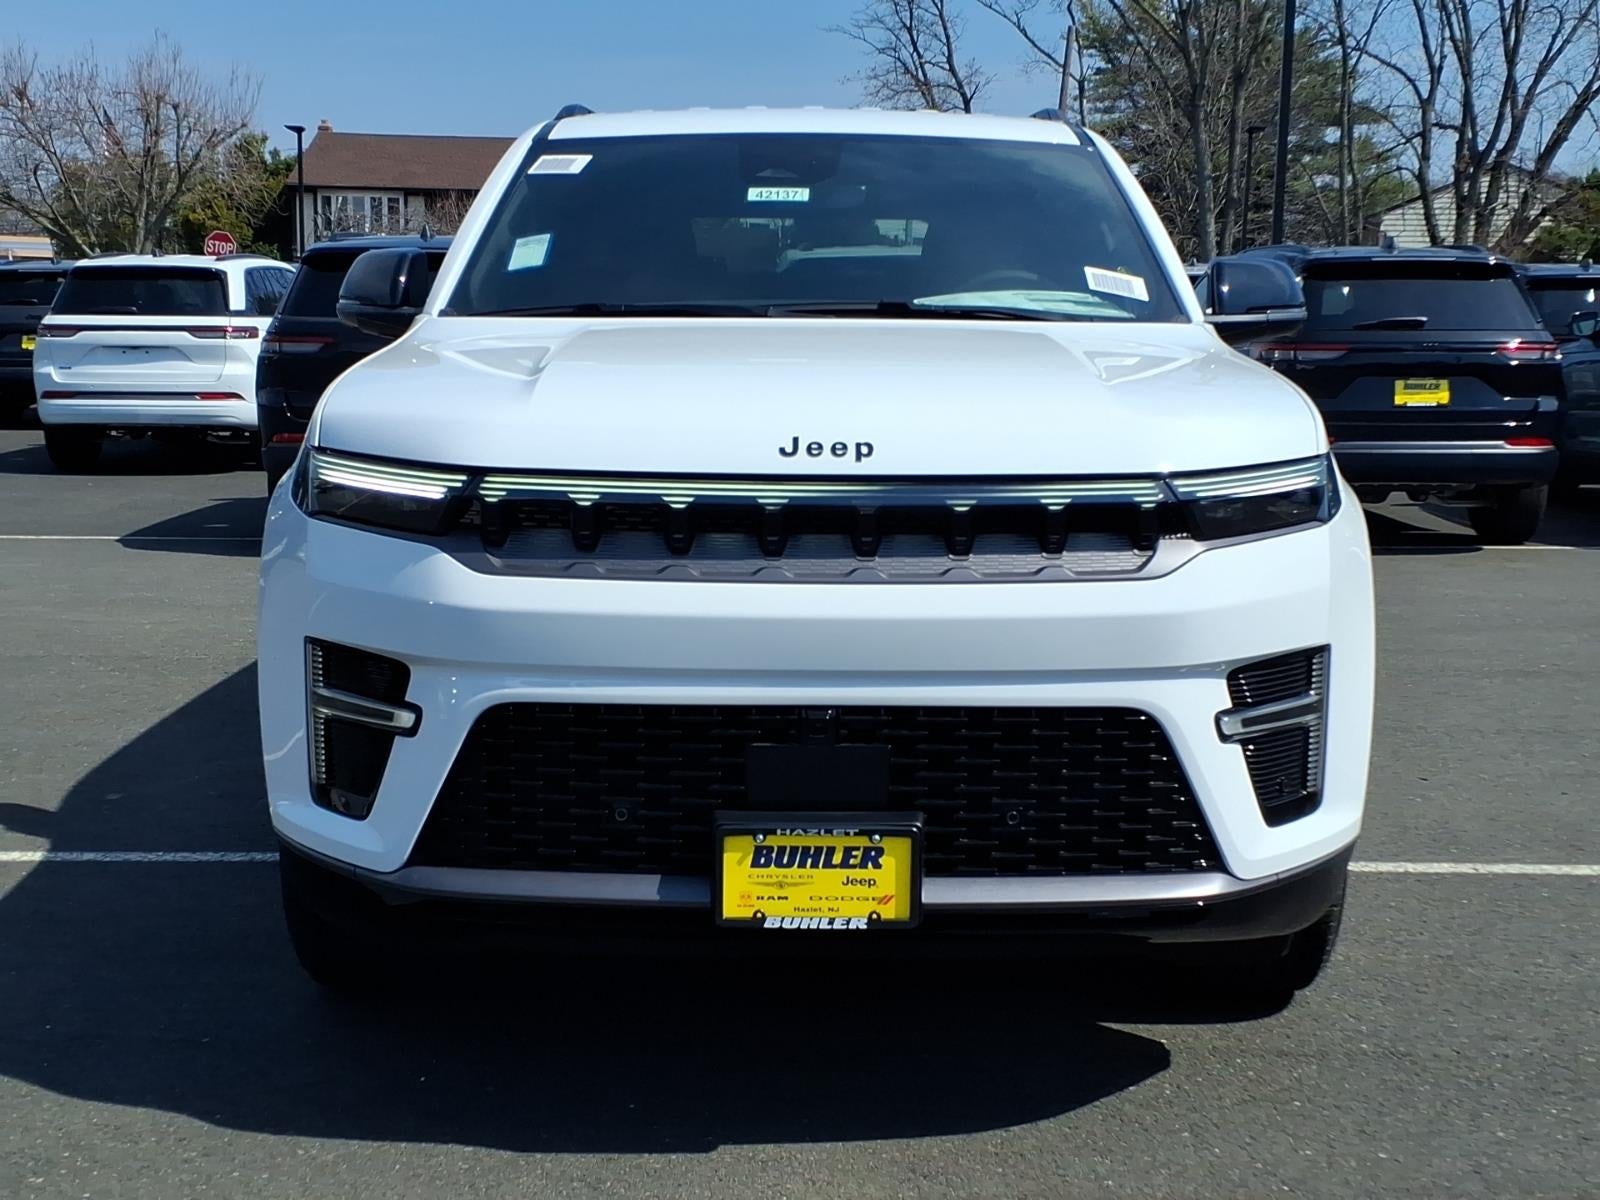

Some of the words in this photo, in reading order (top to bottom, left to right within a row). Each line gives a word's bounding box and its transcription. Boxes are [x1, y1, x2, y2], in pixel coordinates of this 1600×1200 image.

[755, 190, 799, 199] 42137
[207, 240, 234, 255] STOP
[778, 436, 874, 462] Jeep
[776, 828, 859, 837] HAZLET
[750, 844, 885, 869] BUHLER
[841, 875, 877, 888] Jeep
[763, 917, 868, 930] BUHLER
